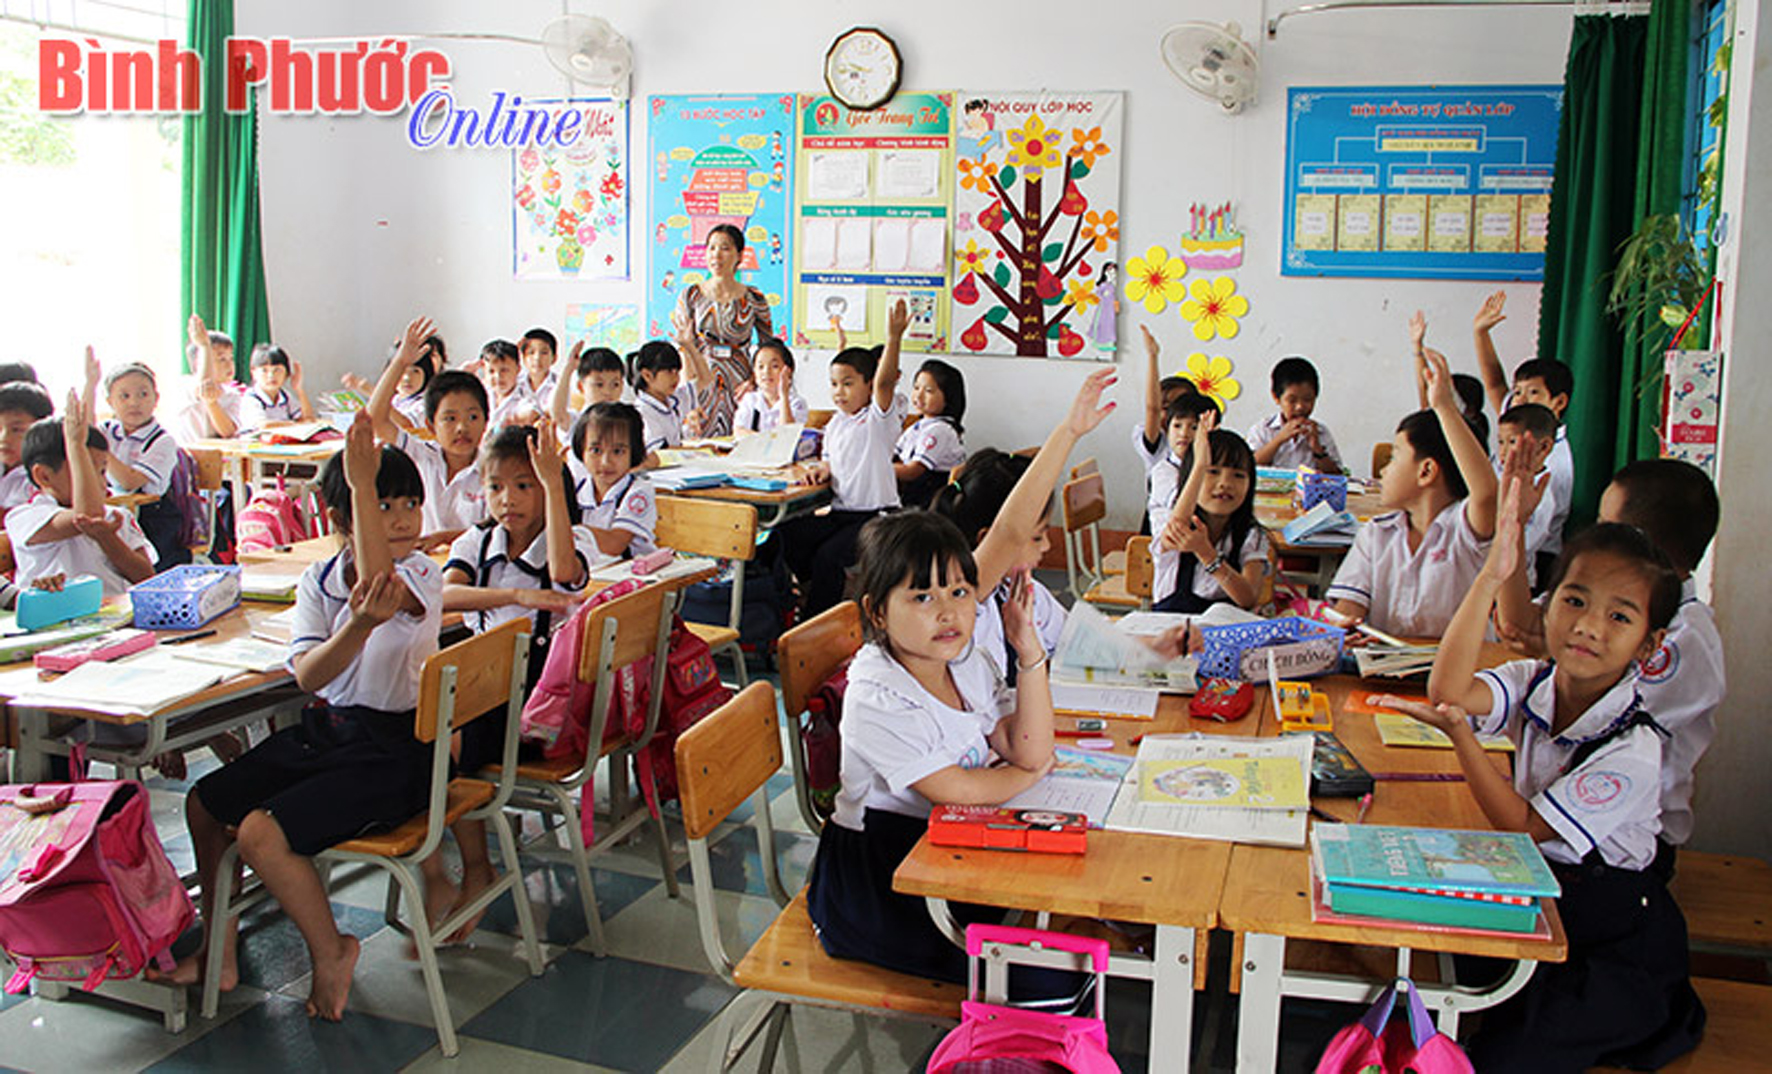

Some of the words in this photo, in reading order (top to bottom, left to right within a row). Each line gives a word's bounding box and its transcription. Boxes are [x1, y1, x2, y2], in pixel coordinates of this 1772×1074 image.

[989, 101, 1010, 114] NỘI
[1012, 102, 1037, 113] QUY
[1040, 101, 1064, 113] LỚP
[1067, 101, 1093, 114] HỌC
[1351, 101, 1376, 117] HỘI
[1486, 101, 1515, 116] LỚP
[1249, 653, 1293, 671] CHCH
